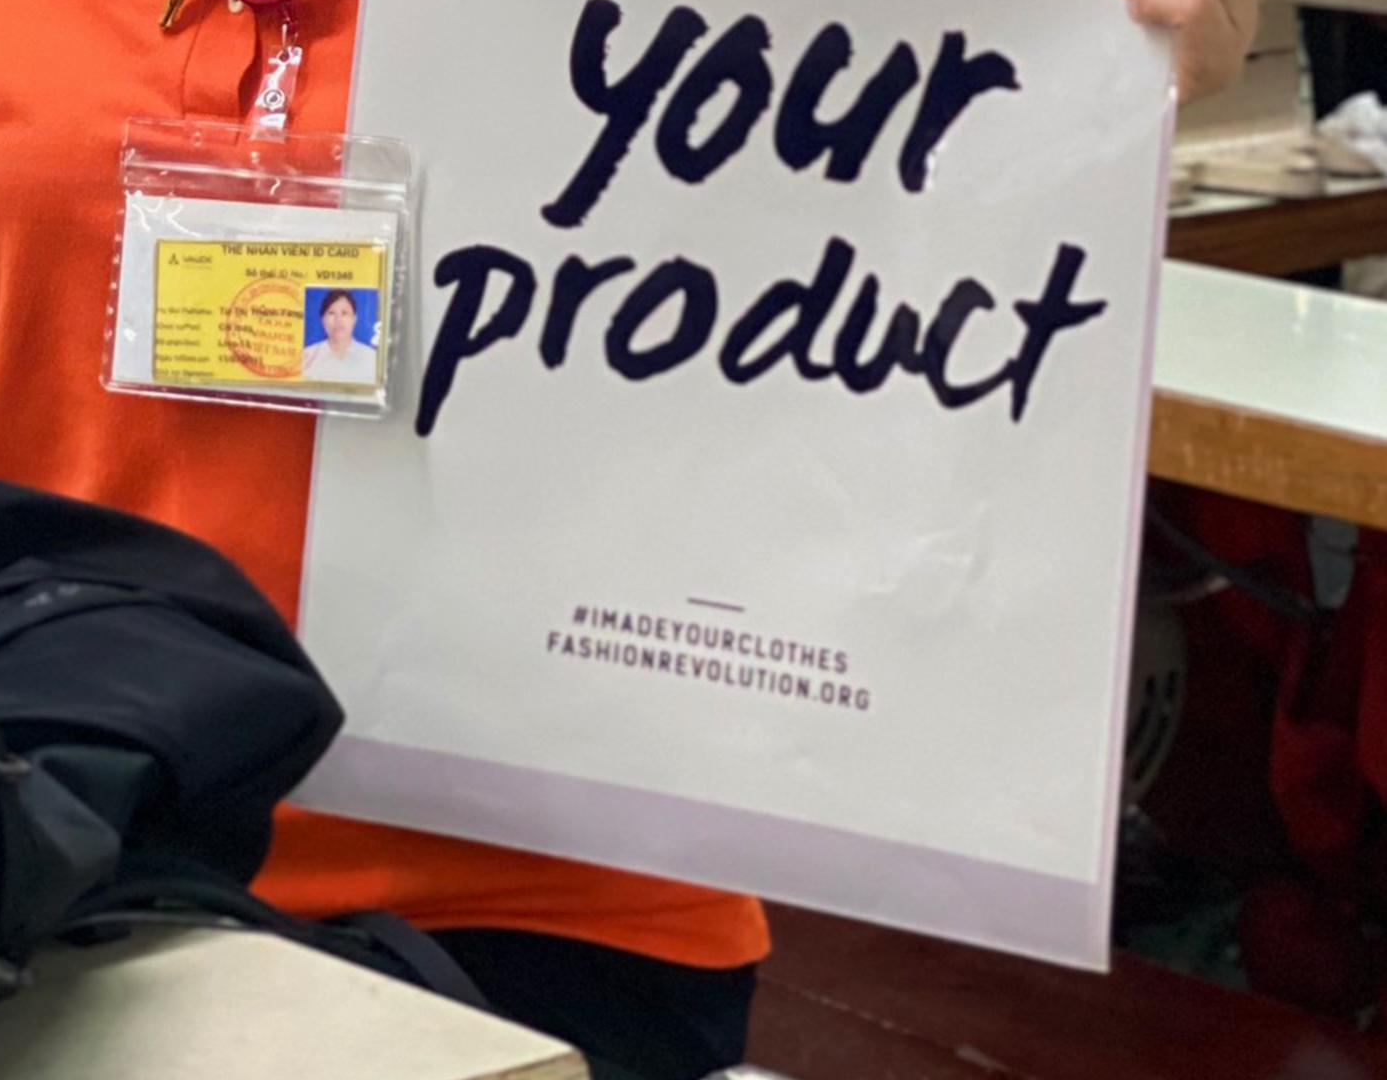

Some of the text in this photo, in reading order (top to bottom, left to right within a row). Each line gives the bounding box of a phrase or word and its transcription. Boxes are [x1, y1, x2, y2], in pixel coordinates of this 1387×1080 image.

[414, 237, 1108, 439] product
[545, 630, 871, 712] FASHIONREVOLUTION.ORG
[572, 605, 849, 674] #IMADEYOURCLOTHES
